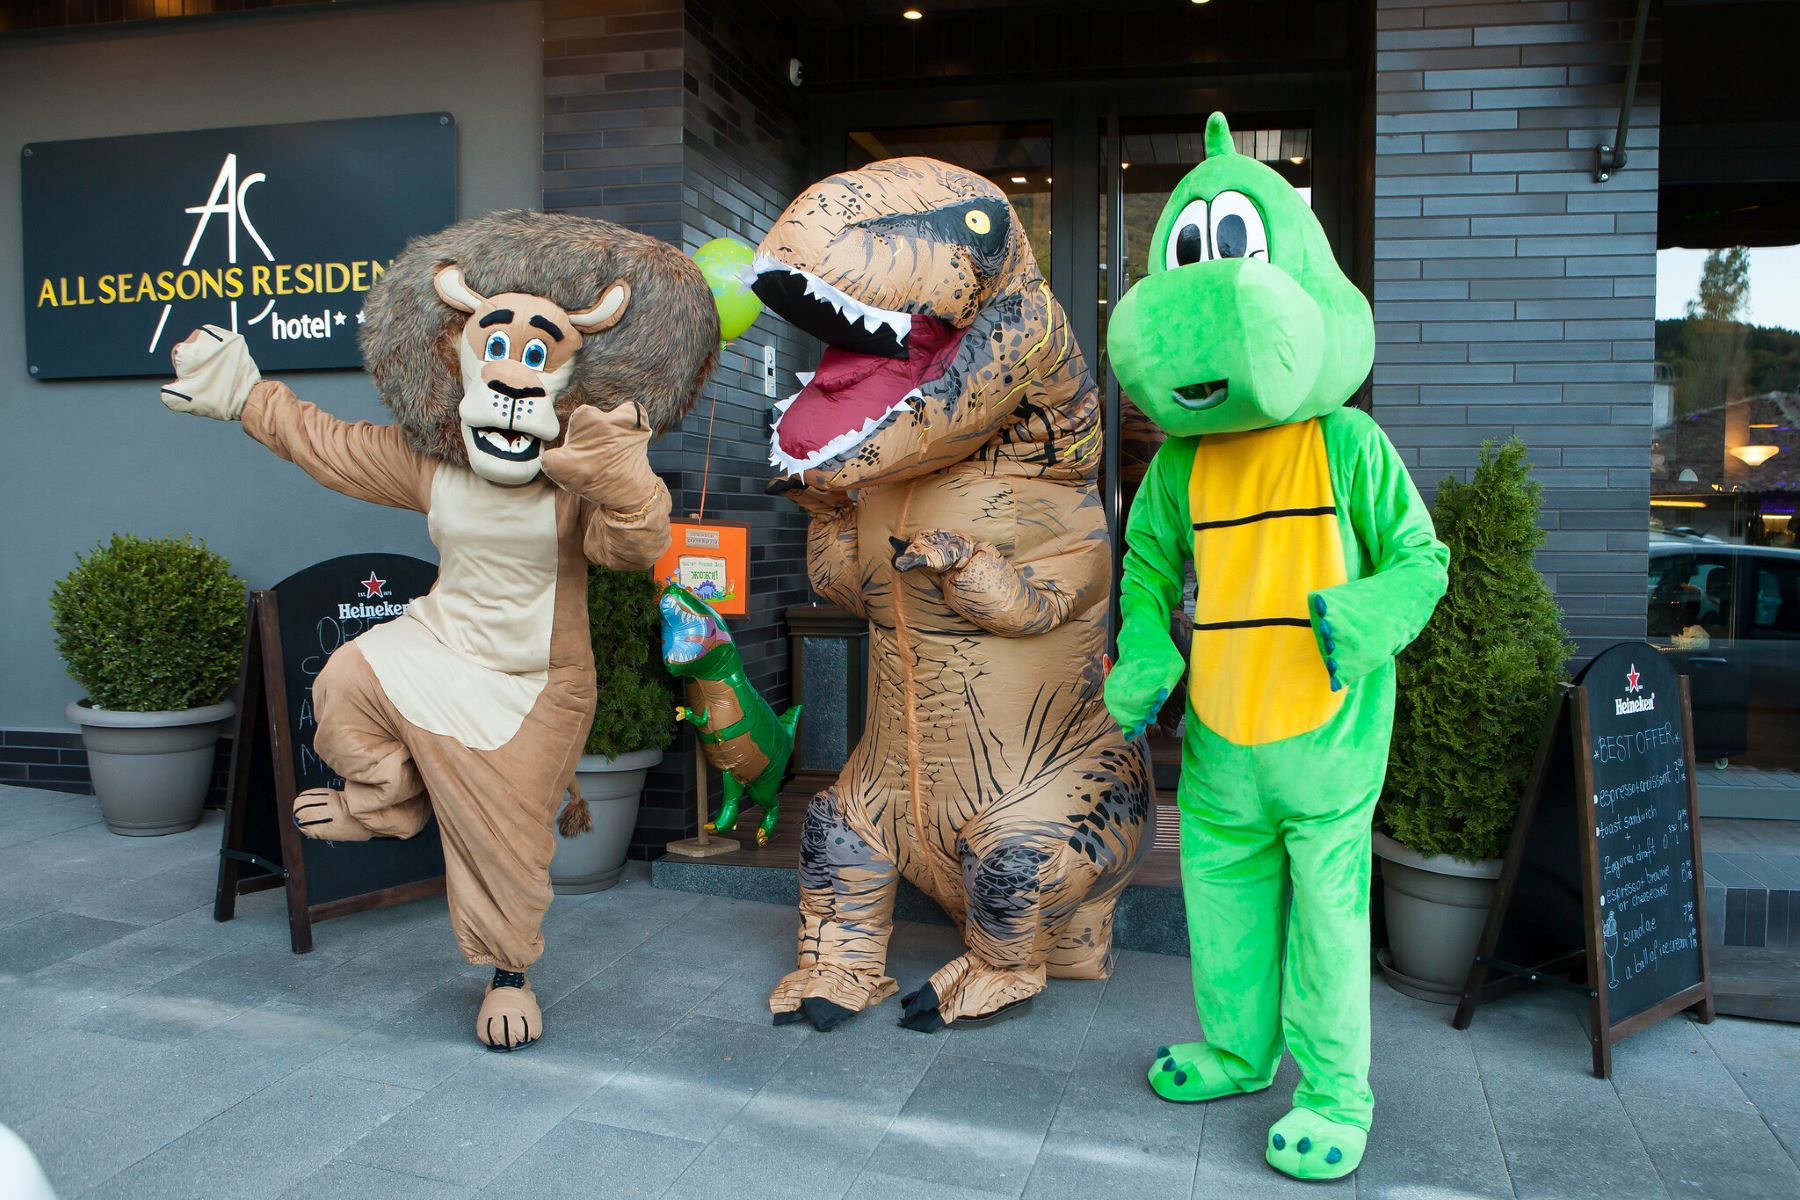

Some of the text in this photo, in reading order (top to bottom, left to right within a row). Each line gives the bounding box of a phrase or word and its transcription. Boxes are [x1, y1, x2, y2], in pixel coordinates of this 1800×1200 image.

[37, 276, 95, 307] ALL
[98, 267, 243, 304] SEASONS
[272, 309, 331, 340] hotel
[1615, 695, 1655, 716] Heineken
[1636, 722, 1675, 754] OFFER
[1600, 804, 1658, 839] toast sandwich
[1623, 913, 1657, 947] sundae
